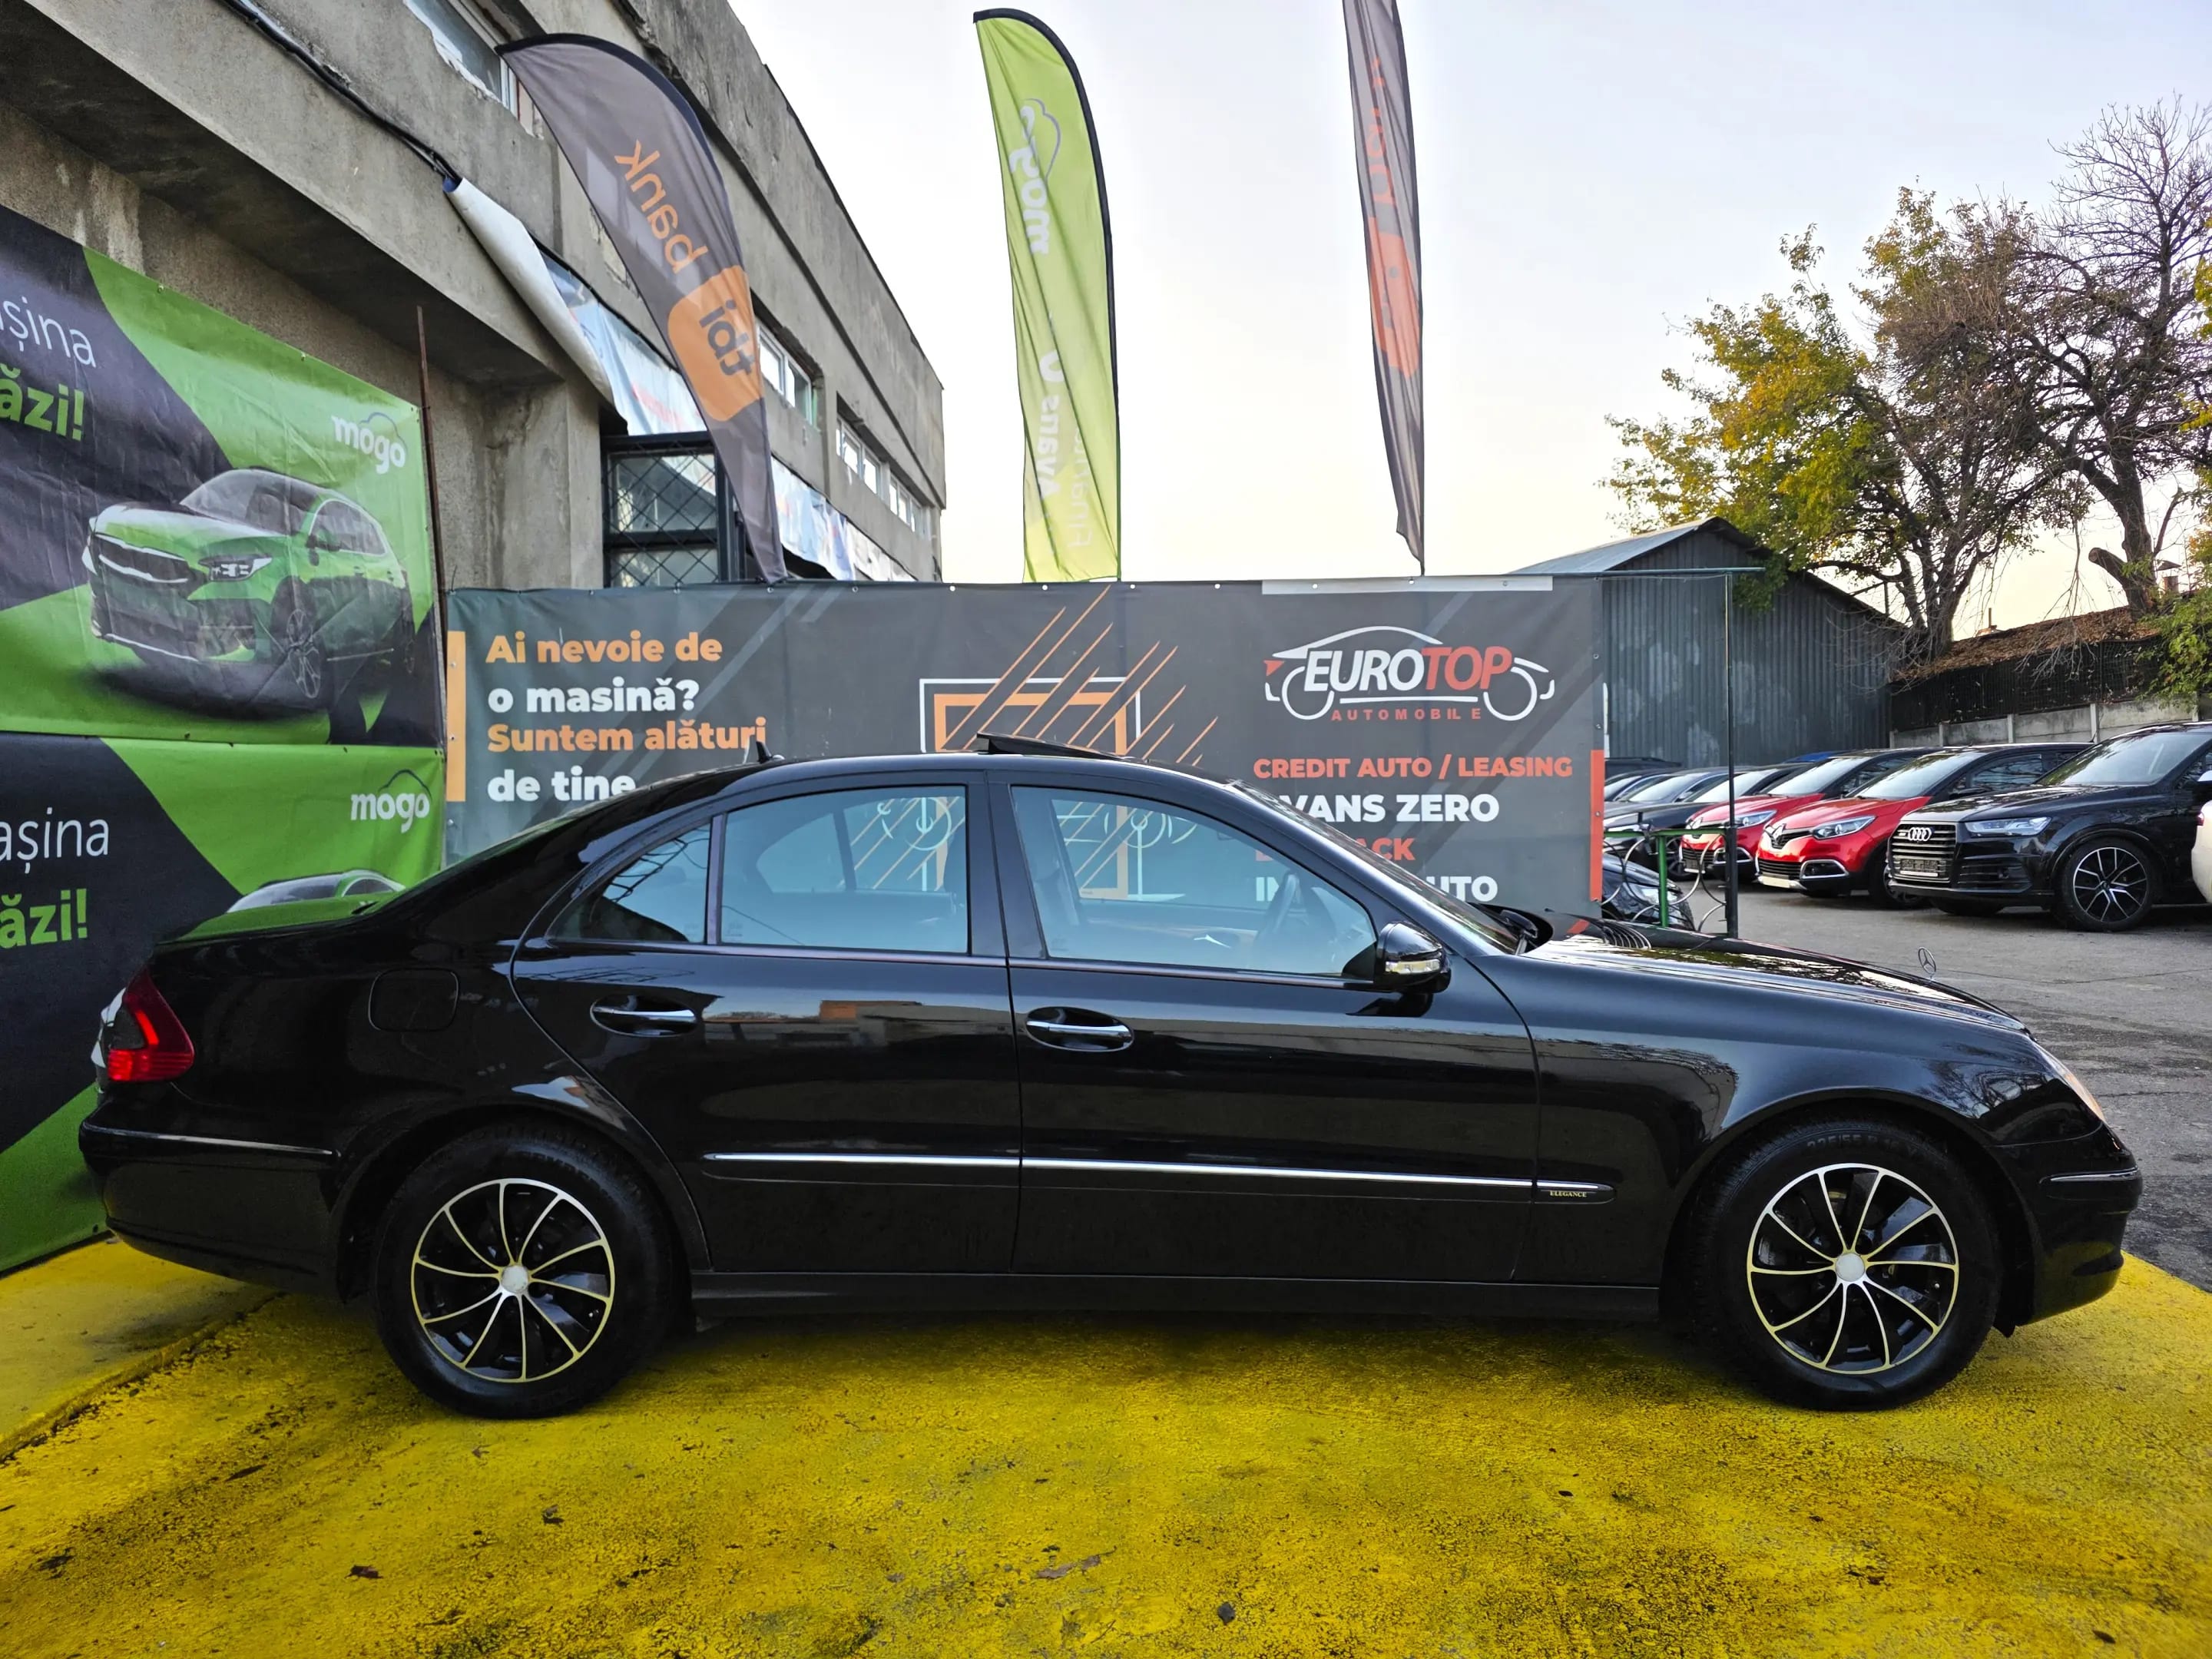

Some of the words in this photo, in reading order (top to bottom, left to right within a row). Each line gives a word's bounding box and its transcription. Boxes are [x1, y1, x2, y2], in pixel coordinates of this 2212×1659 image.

[0, 296, 96, 368] șina
[331, 414, 406, 474] mogo
[485, 631, 526, 664] Ai
[538, 630, 664, 663] nevoie
[675, 631, 723, 662] de
[1304, 646, 1513, 692] EUROTOP
[488, 687, 514, 713] o
[526, 676, 700, 713] masină?
[1331, 708, 1482, 721] AUTOMOBILE
[487, 724, 634, 753] Suntem
[645, 716, 767, 750] alături
[487, 769, 541, 802] de
[551, 766, 636, 801] tine
[1253, 757, 1350, 779] CREDIT
[1357, 757, 1432, 778] AUTO
[1459, 756, 1573, 777] LEASING
[350, 791, 430, 833] mogo
[1278, 794, 1386, 823] VANS
[1396, 793, 1500, 823] ZERO
